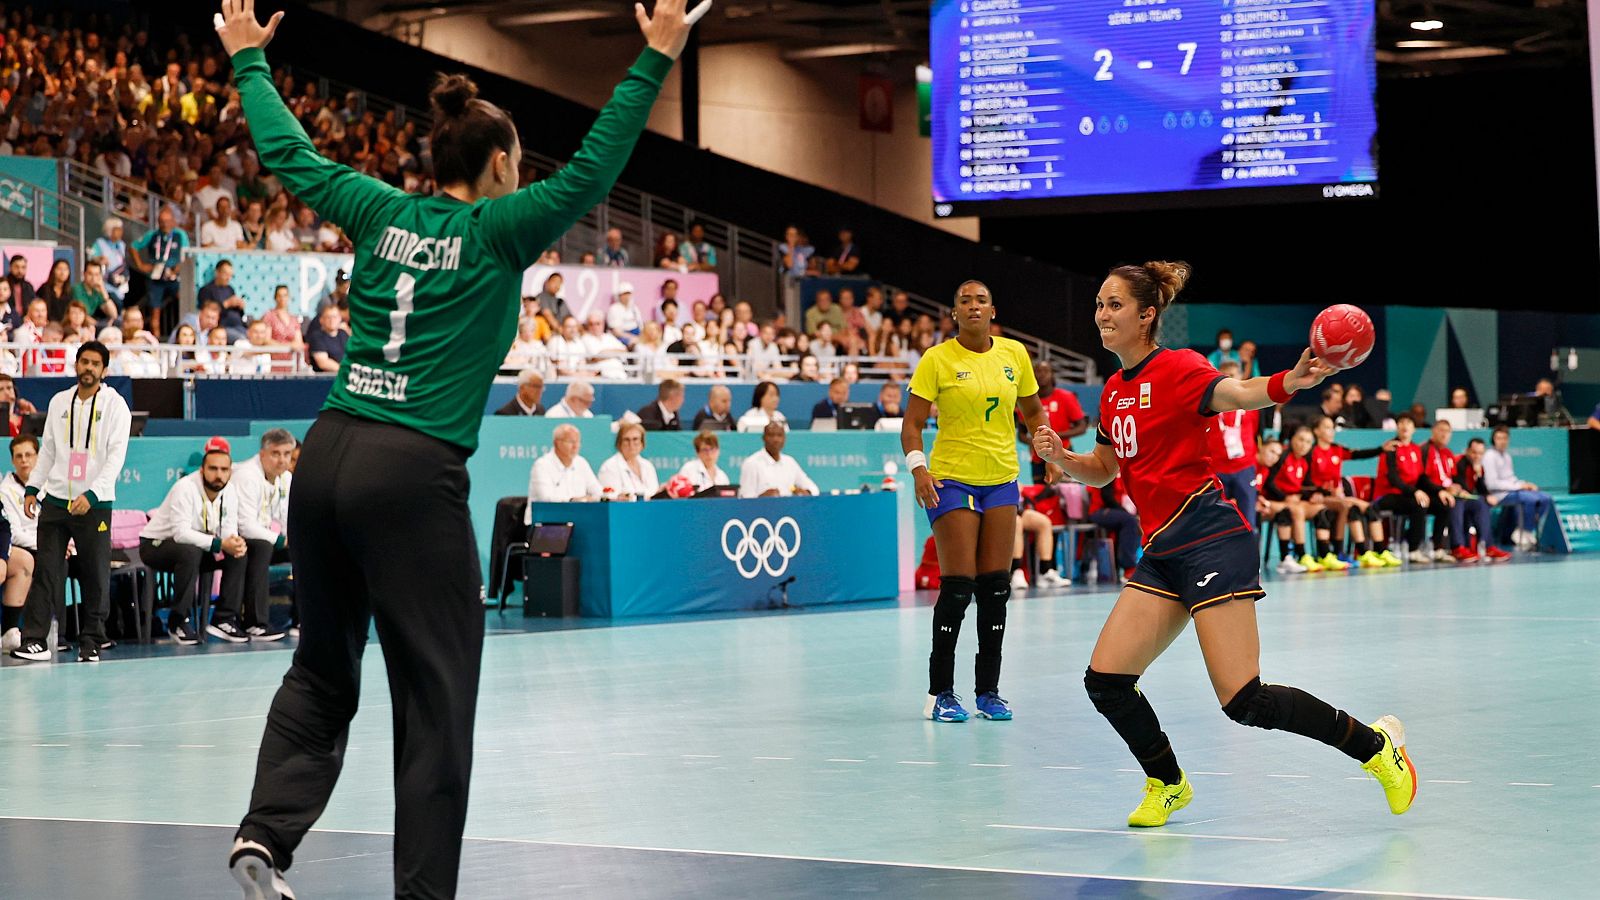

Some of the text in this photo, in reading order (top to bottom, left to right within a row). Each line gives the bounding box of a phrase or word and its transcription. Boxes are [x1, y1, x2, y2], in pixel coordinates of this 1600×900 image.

[1094, 48, 1113, 81] 2
[1178, 42, 1197, 75] 7
[1333, 184, 1374, 197] OMEGA
[382, 272, 416, 363] 1
[985, 396, 999, 422] 7
[1116, 397, 1136, 410] ESP
[1111, 414, 1138, 459] 99
